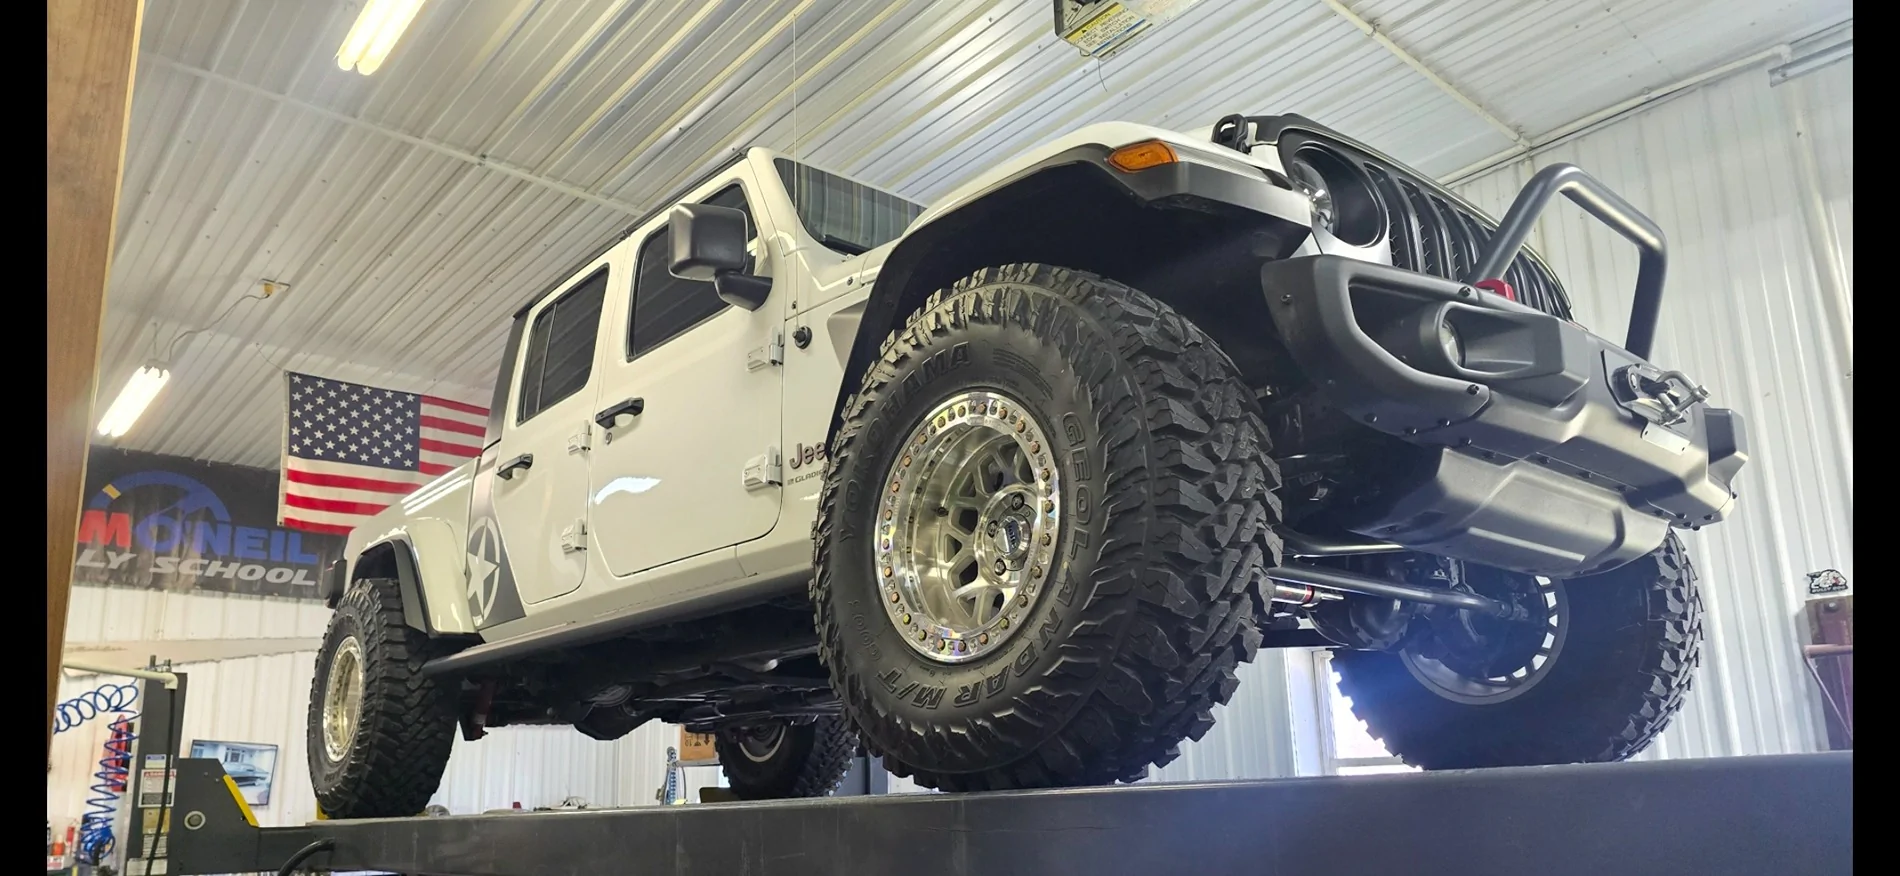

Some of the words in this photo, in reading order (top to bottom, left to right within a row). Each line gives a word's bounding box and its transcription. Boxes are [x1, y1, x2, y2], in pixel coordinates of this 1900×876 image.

[1085, 13, 1111, 30] CAUTION
[789, 441, 826, 470] Jee
[839, 340, 972, 544] YOKOHAMA
[149, 555, 317, 586] SCHOOL
[952, 411, 1093, 708] GEOLANDAR
[874, 667, 947, 710] M/T
